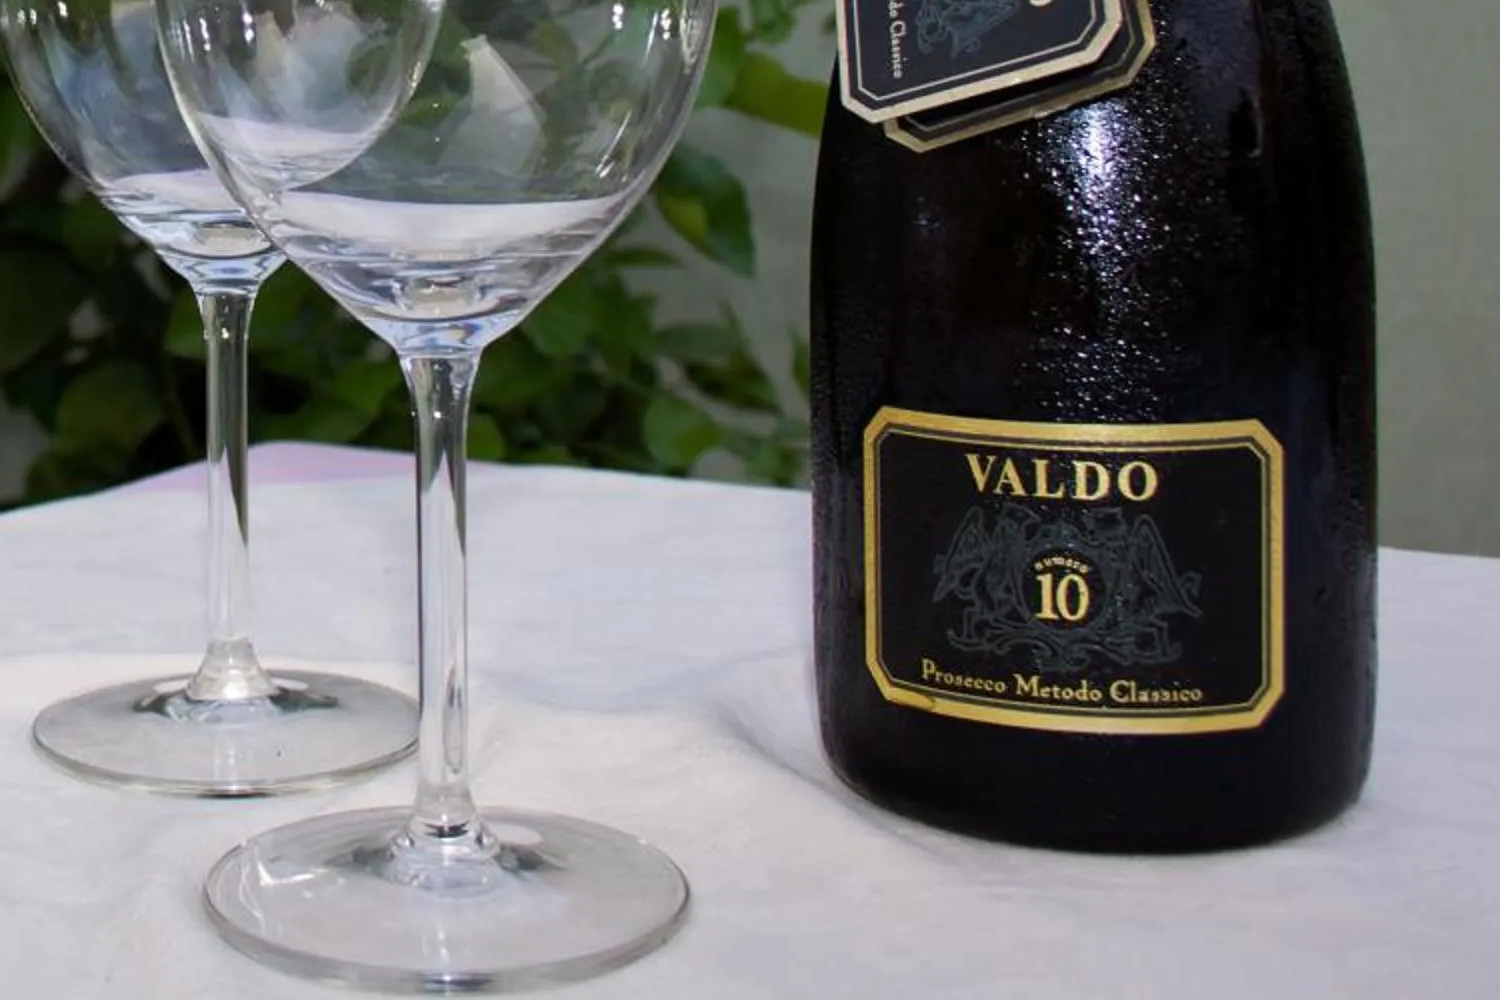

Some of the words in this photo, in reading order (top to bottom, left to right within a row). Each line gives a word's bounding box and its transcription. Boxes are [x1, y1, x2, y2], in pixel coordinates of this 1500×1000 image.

[965, 453, 1159, 502] VALDO
[1035, 573, 1090, 622] 10
[920, 658, 1006, 693] Prosecco
[1012, 673, 1102, 701] Metodo
[1109, 679, 1204, 703] Classico
